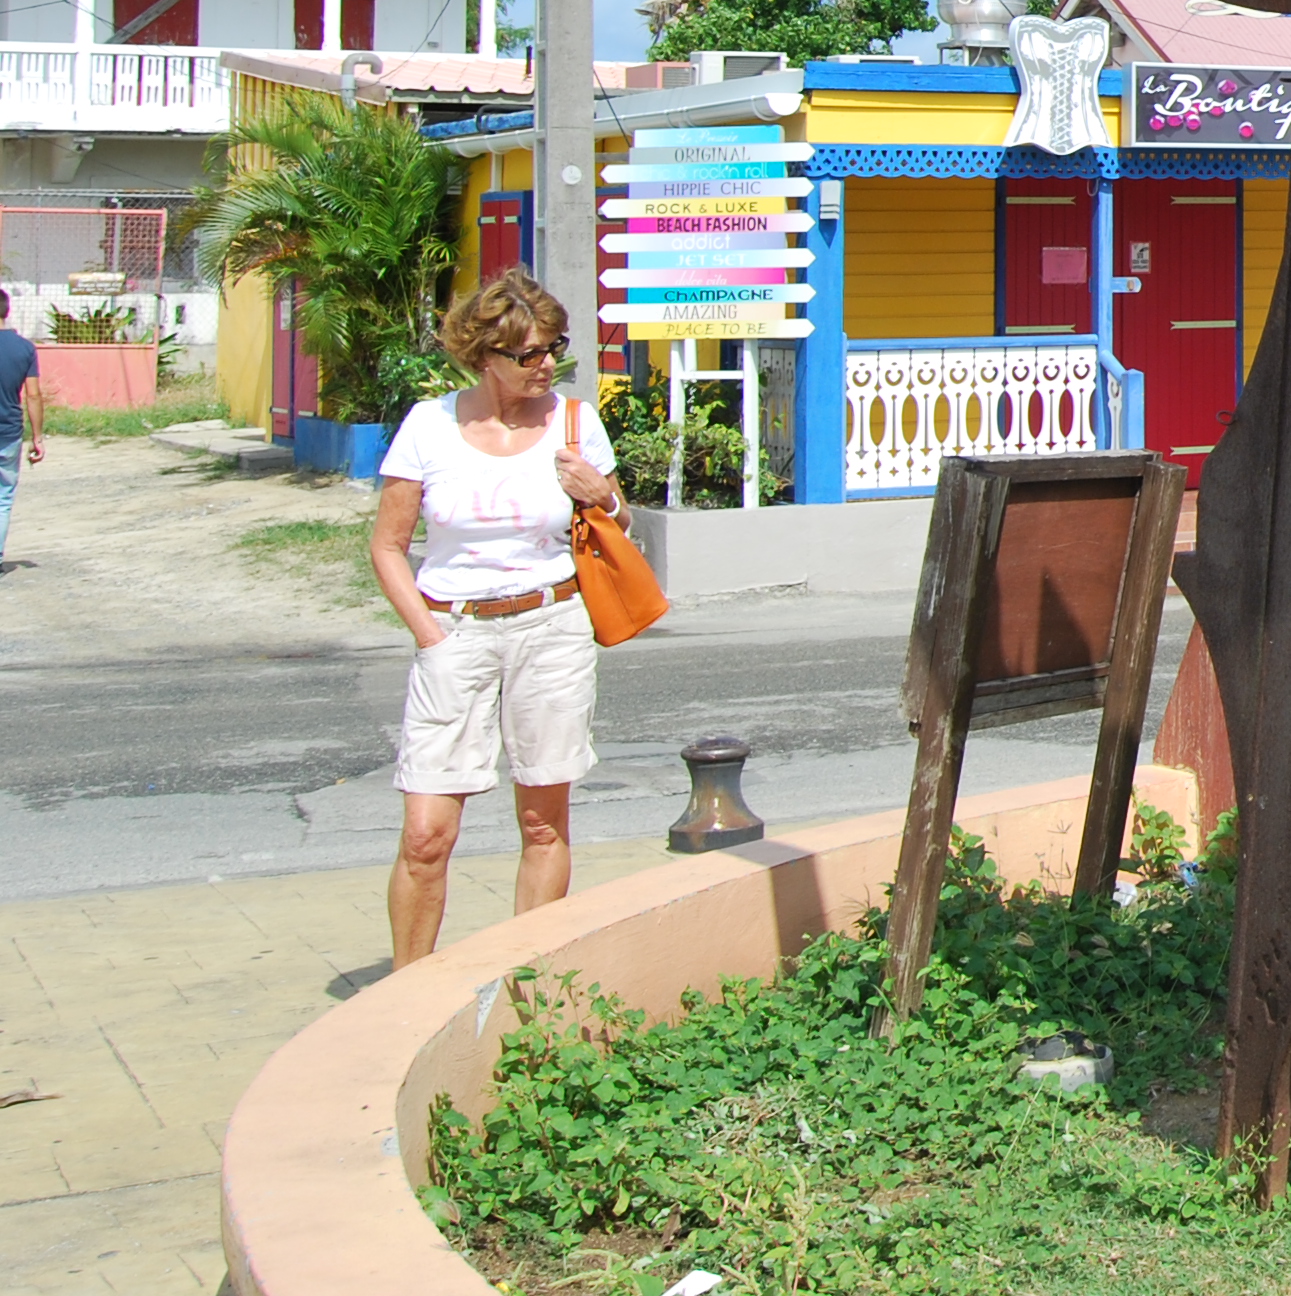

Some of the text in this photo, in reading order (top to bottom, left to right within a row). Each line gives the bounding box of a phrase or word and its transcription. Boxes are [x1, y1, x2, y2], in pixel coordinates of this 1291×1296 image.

[1142, 75, 1170, 94] La
[674, 146, 751, 163] ORIGINAL
[745, 162, 769, 179] roll
[664, 181, 762, 196] HIPPIE CHIC
[645, 202, 759, 214] ROCK & LUXE
[657, 216, 768, 233] BEACH FASHION
[671, 234, 731, 250] addict
[675, 253, 748, 266] JET SET
[675, 270, 727, 286] dolce vita
[662, 304, 738, 320] AMAZING
[662, 322, 767, 337] PLACE TO BE
